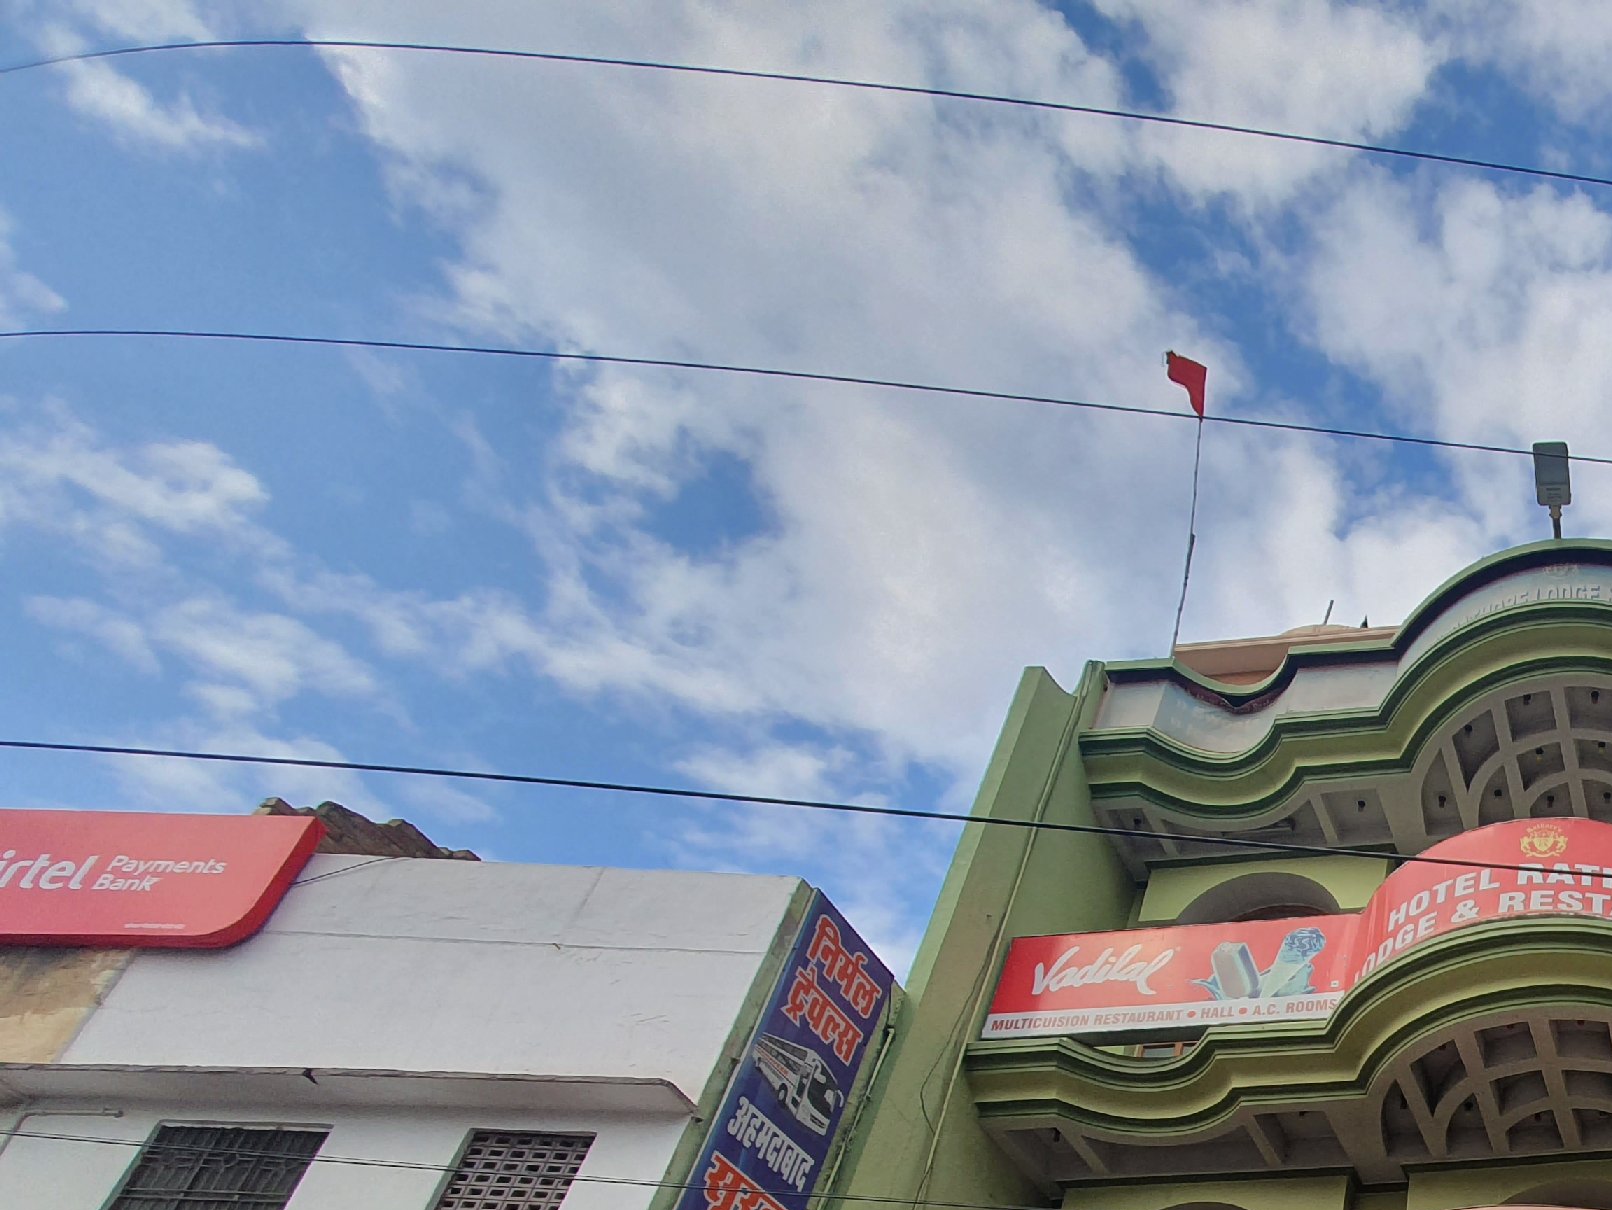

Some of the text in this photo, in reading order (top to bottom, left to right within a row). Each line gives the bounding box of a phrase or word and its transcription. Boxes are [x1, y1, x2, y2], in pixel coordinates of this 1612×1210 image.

[0, 850, 227, 890] irtel Payments
[92, 873, 161, 892] Bank
[1387, 869, 1501, 931] HOTEL
[1450, 899, 1480, 924] &
[806, 914, 882, 1019] निर्मल
[1031, 944, 1175, 995] Vadilal
[781, 966, 863, 1066] ट्रेवल्स
[991, 998, 1337, 1031] MULTICUISION RESTAURANT HALL A.C. ROOMS
[727, 1096, 815, 1190] अहमदाबाद
